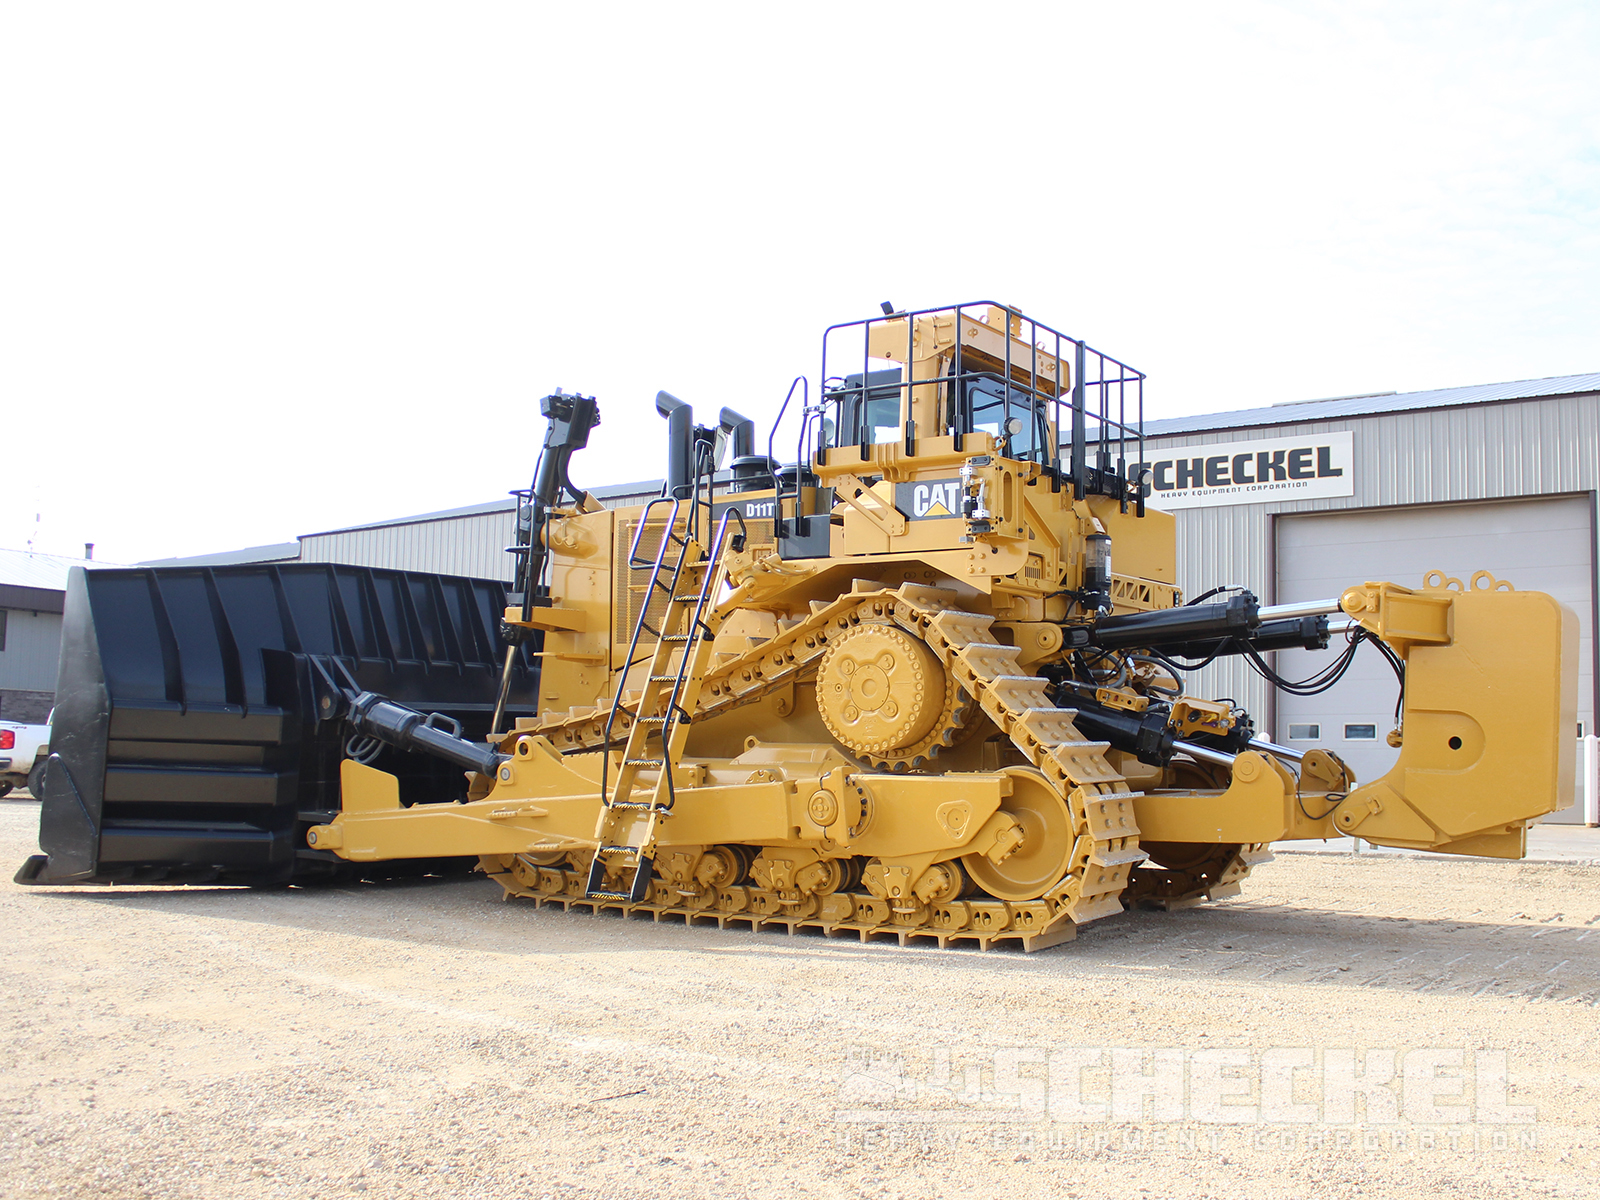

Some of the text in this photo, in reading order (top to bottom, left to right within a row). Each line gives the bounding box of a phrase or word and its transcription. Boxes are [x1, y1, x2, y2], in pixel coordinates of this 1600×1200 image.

[1160, 481, 1308, 499] HEAVY EQUIPMENT CORPORATION
[913, 482, 960, 518] CAT
[746, 502, 775, 517] D11T
